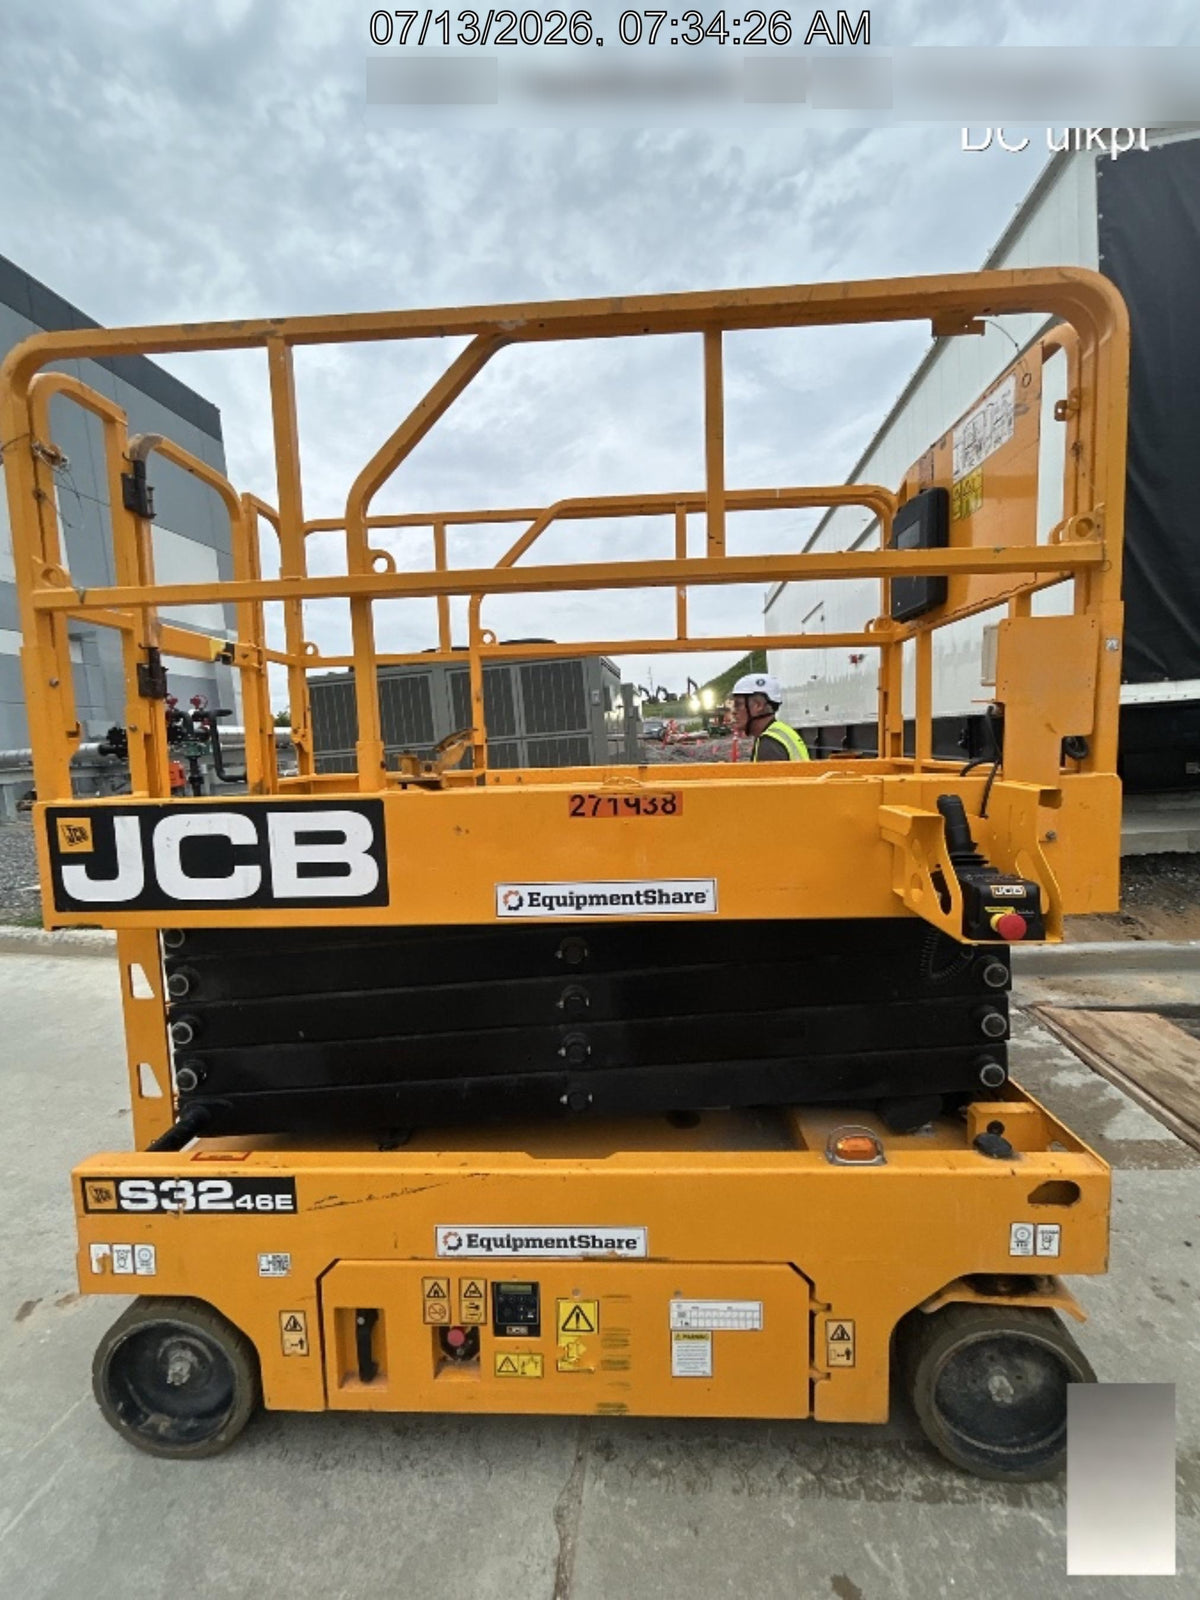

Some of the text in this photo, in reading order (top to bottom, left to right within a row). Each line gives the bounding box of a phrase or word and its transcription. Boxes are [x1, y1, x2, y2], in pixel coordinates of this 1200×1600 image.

[61, 810, 379, 902] JCB
[527, 888, 708, 911] EquipmentShare
[466, 1233, 638, 1252] EquipmentShare
